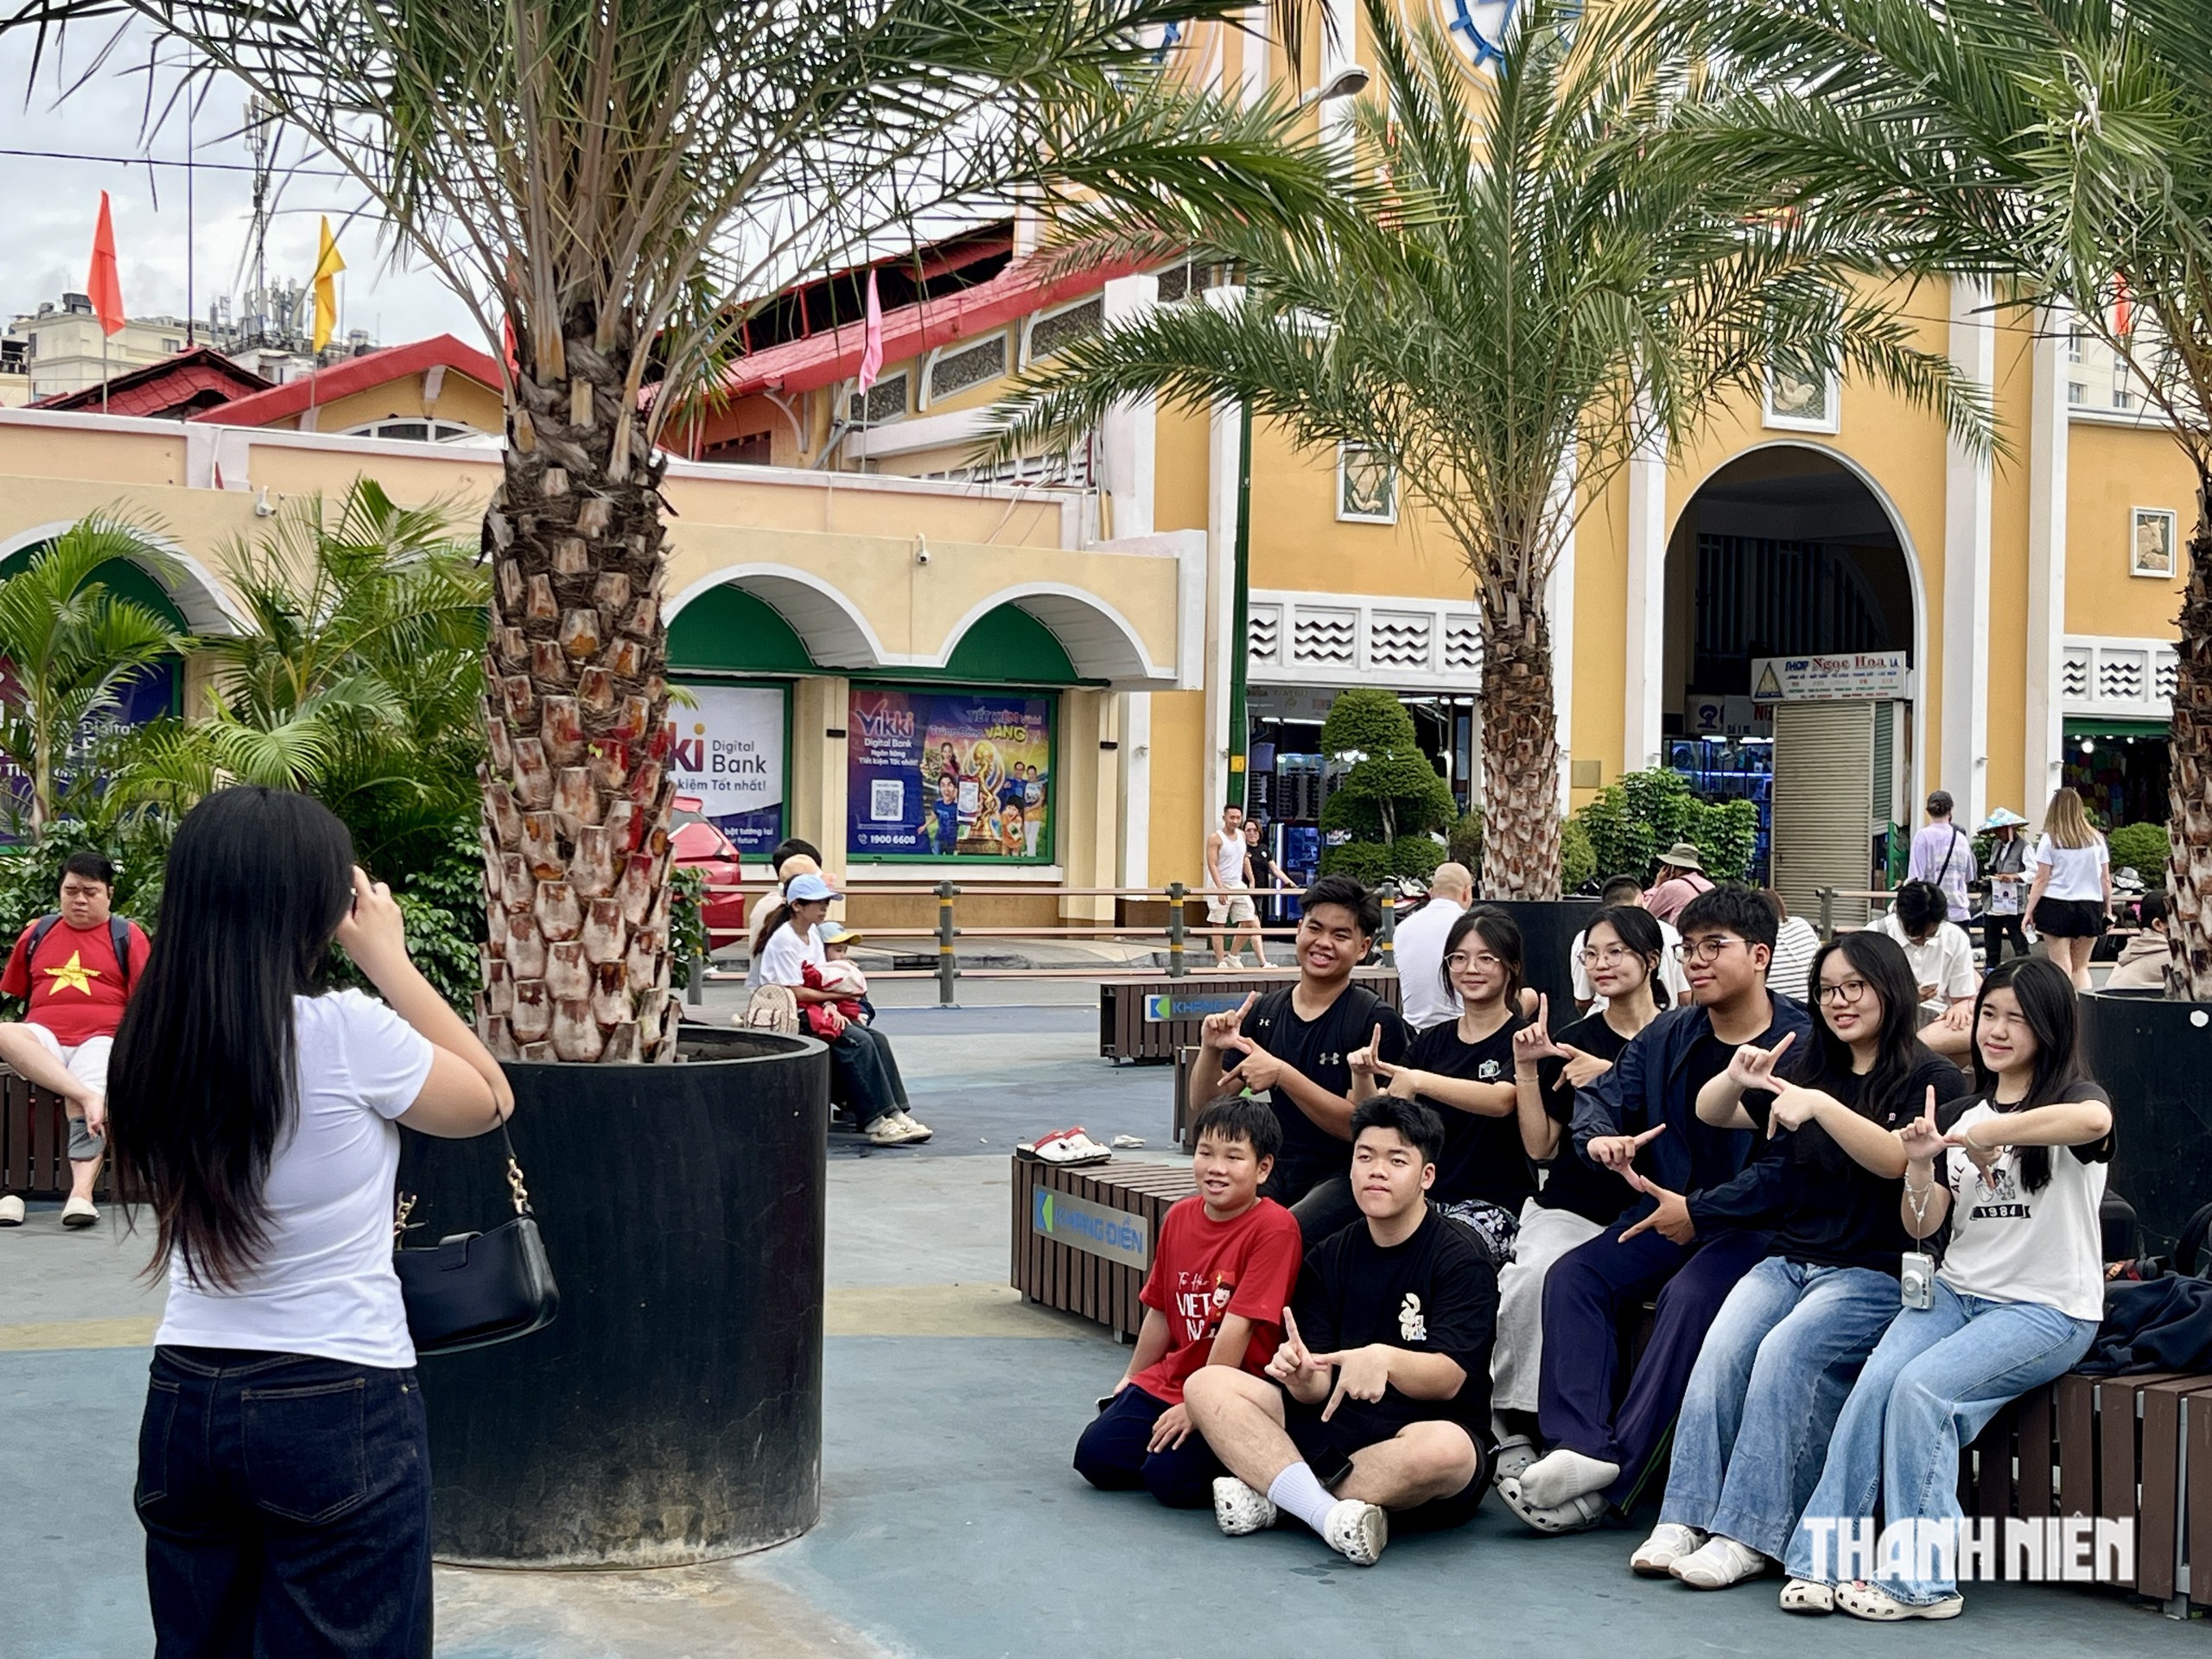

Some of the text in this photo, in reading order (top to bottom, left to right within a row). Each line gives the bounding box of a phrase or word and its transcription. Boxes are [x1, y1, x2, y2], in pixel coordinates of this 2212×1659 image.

[1854, 656, 1886, 669] Hoa
[855, 699, 914, 738] Vikki
[668, 722, 704, 772] ki
[712, 741, 754, 754] Digital
[865, 738, 912, 748] Digital Bank
[712, 754, 766, 773] Bank
[677, 779, 708, 793] kiệm
[711, 778, 732, 791] Tốt
[870, 835, 892, 843] 1900
[1980, 1205, 2017, 1217] 1984
